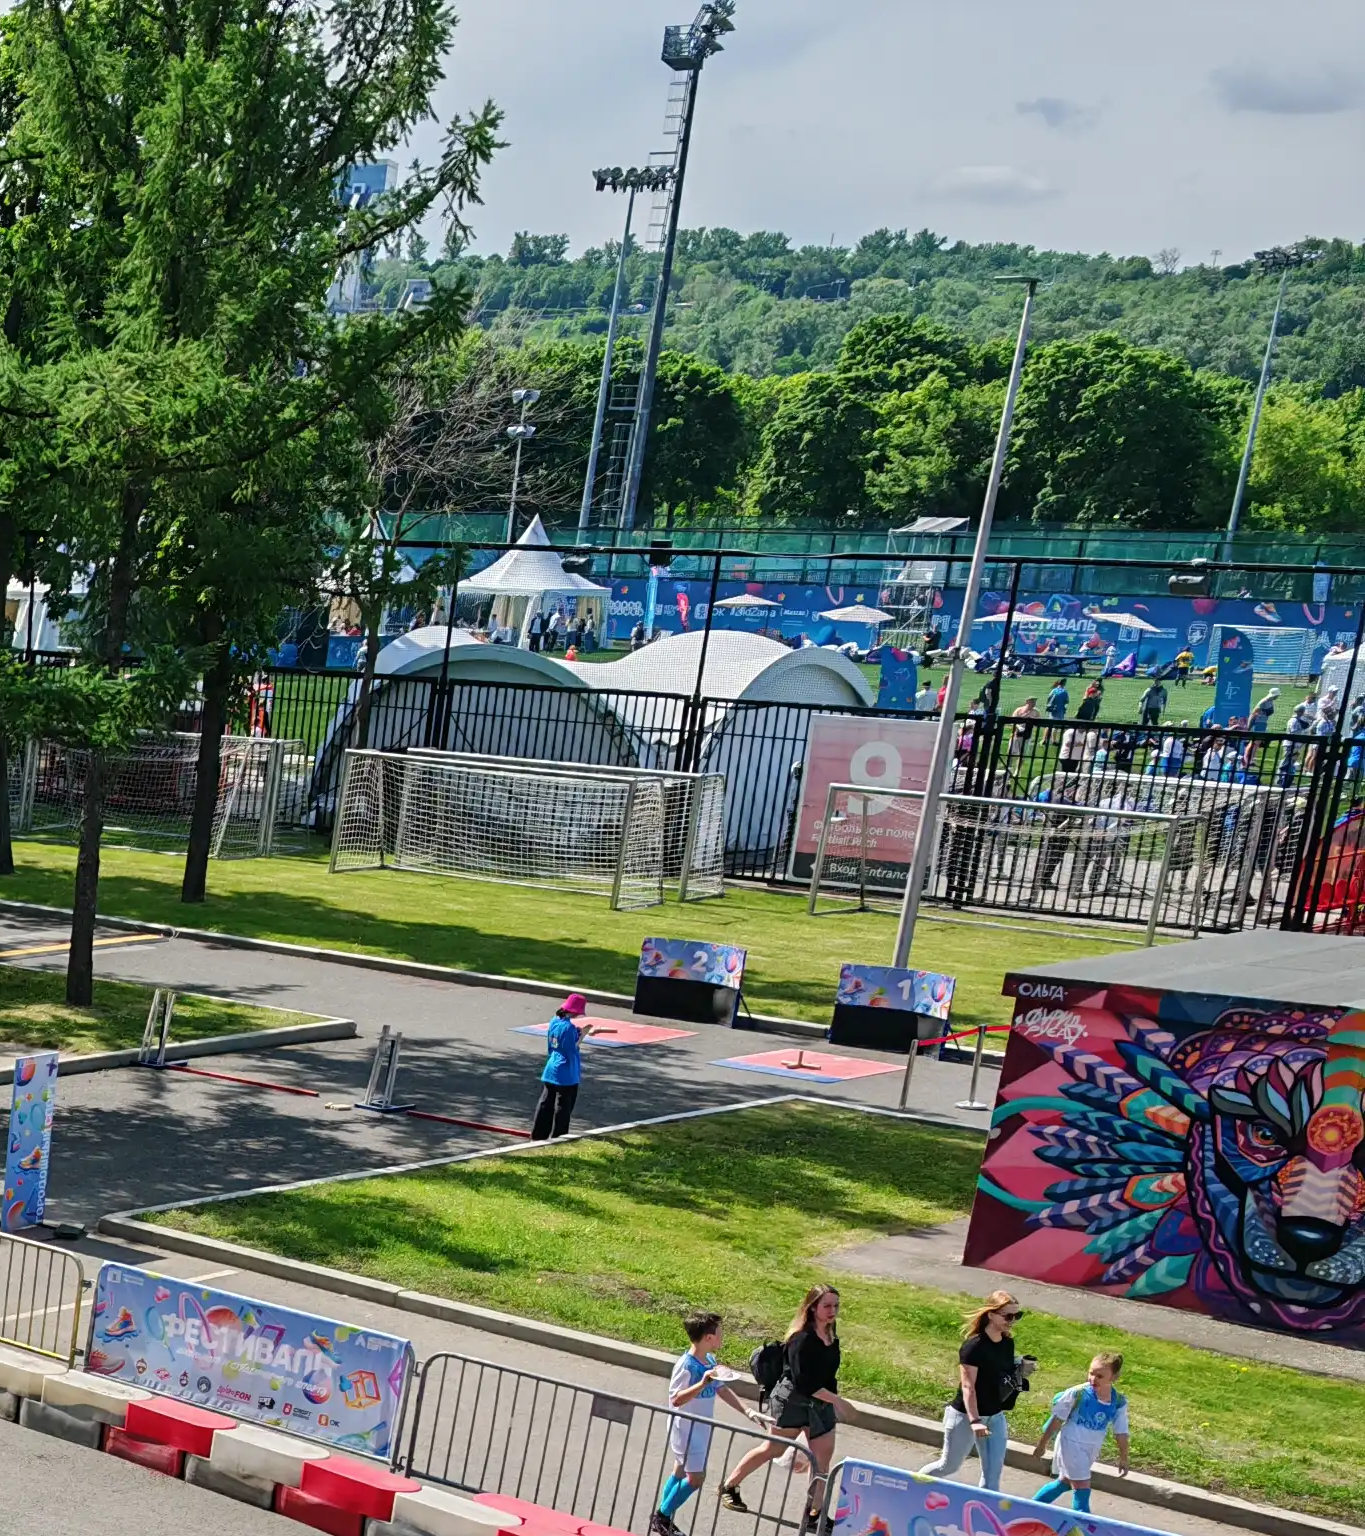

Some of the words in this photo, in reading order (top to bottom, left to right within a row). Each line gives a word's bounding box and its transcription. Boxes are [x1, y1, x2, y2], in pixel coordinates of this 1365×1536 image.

[1011, 617, 1098, 633] ЕСТИВАЛЬ
[847, 741, 903, 816] 9
[885, 827, 915, 841] поле
[829, 862, 858, 876] Вход
[691, 951, 709, 972] 2
[897, 979, 912, 1001] 1
[160, 1312, 333, 1376] ФЕСТИВАЛЬ
